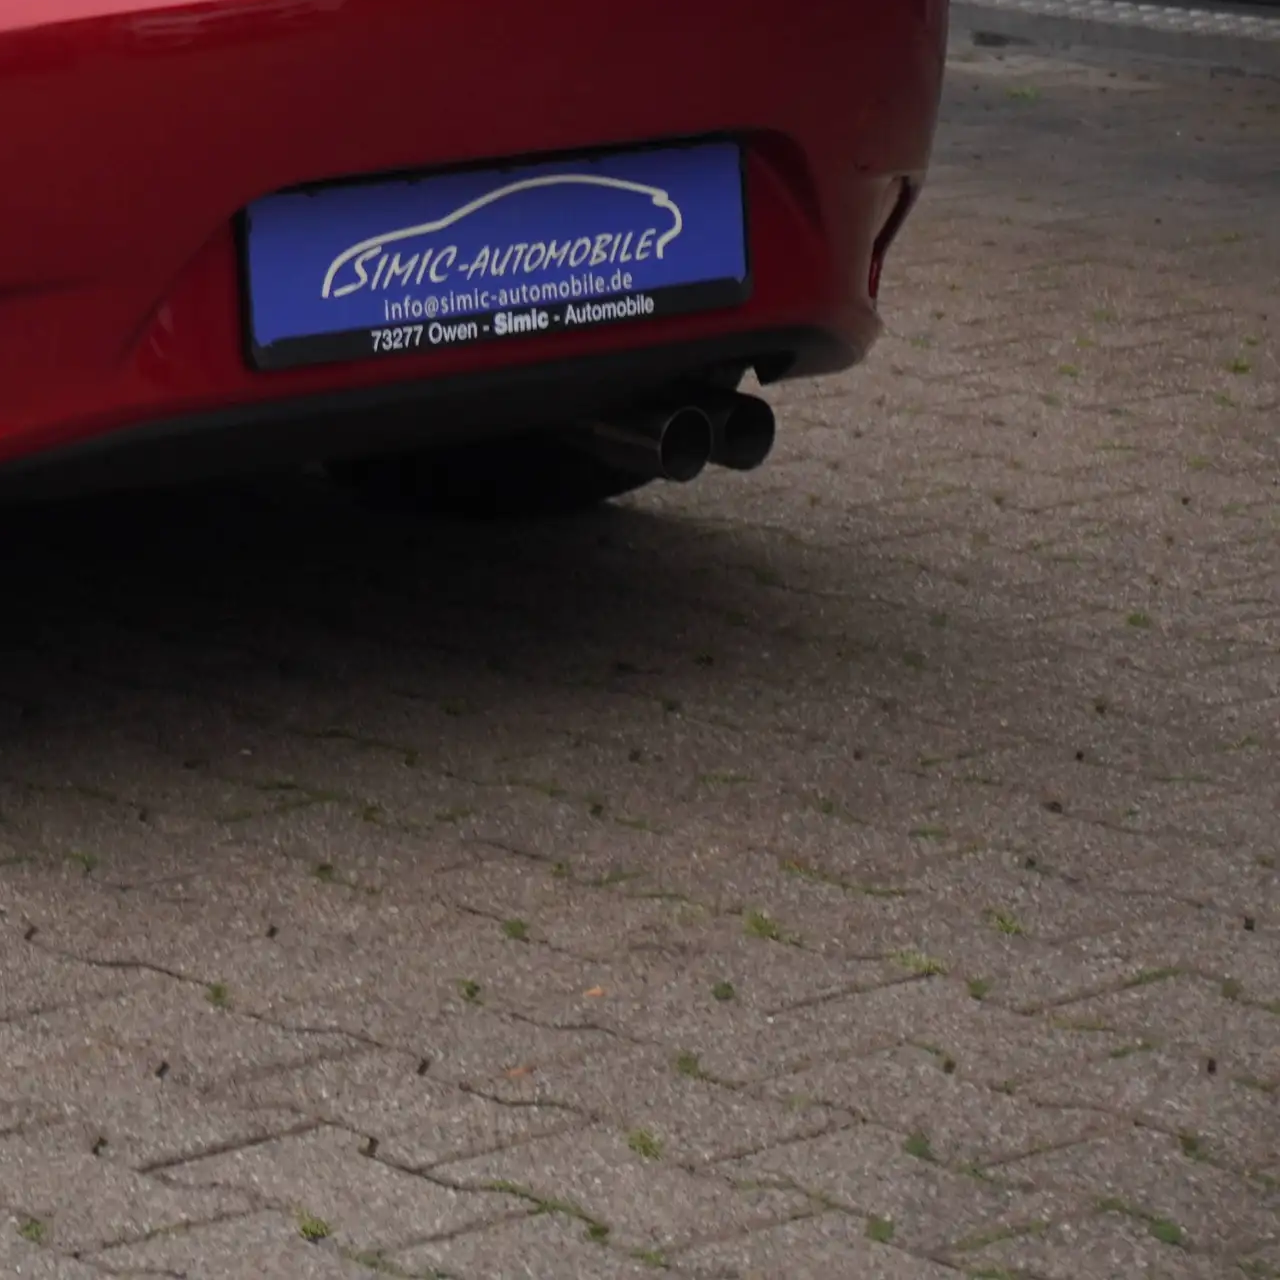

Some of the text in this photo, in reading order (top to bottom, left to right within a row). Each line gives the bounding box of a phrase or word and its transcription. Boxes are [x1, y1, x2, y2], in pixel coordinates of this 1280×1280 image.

[333, 227, 656, 298] SIMIC-AUTOMOBILE
[371, 323, 424, 352] 73277
[428, 321, 478, 345] Owen
[494, 307, 549, 336] Simic
[564, 293, 655, 324] Automobile
[384, 267, 633, 321] info@simic-automobile.de
